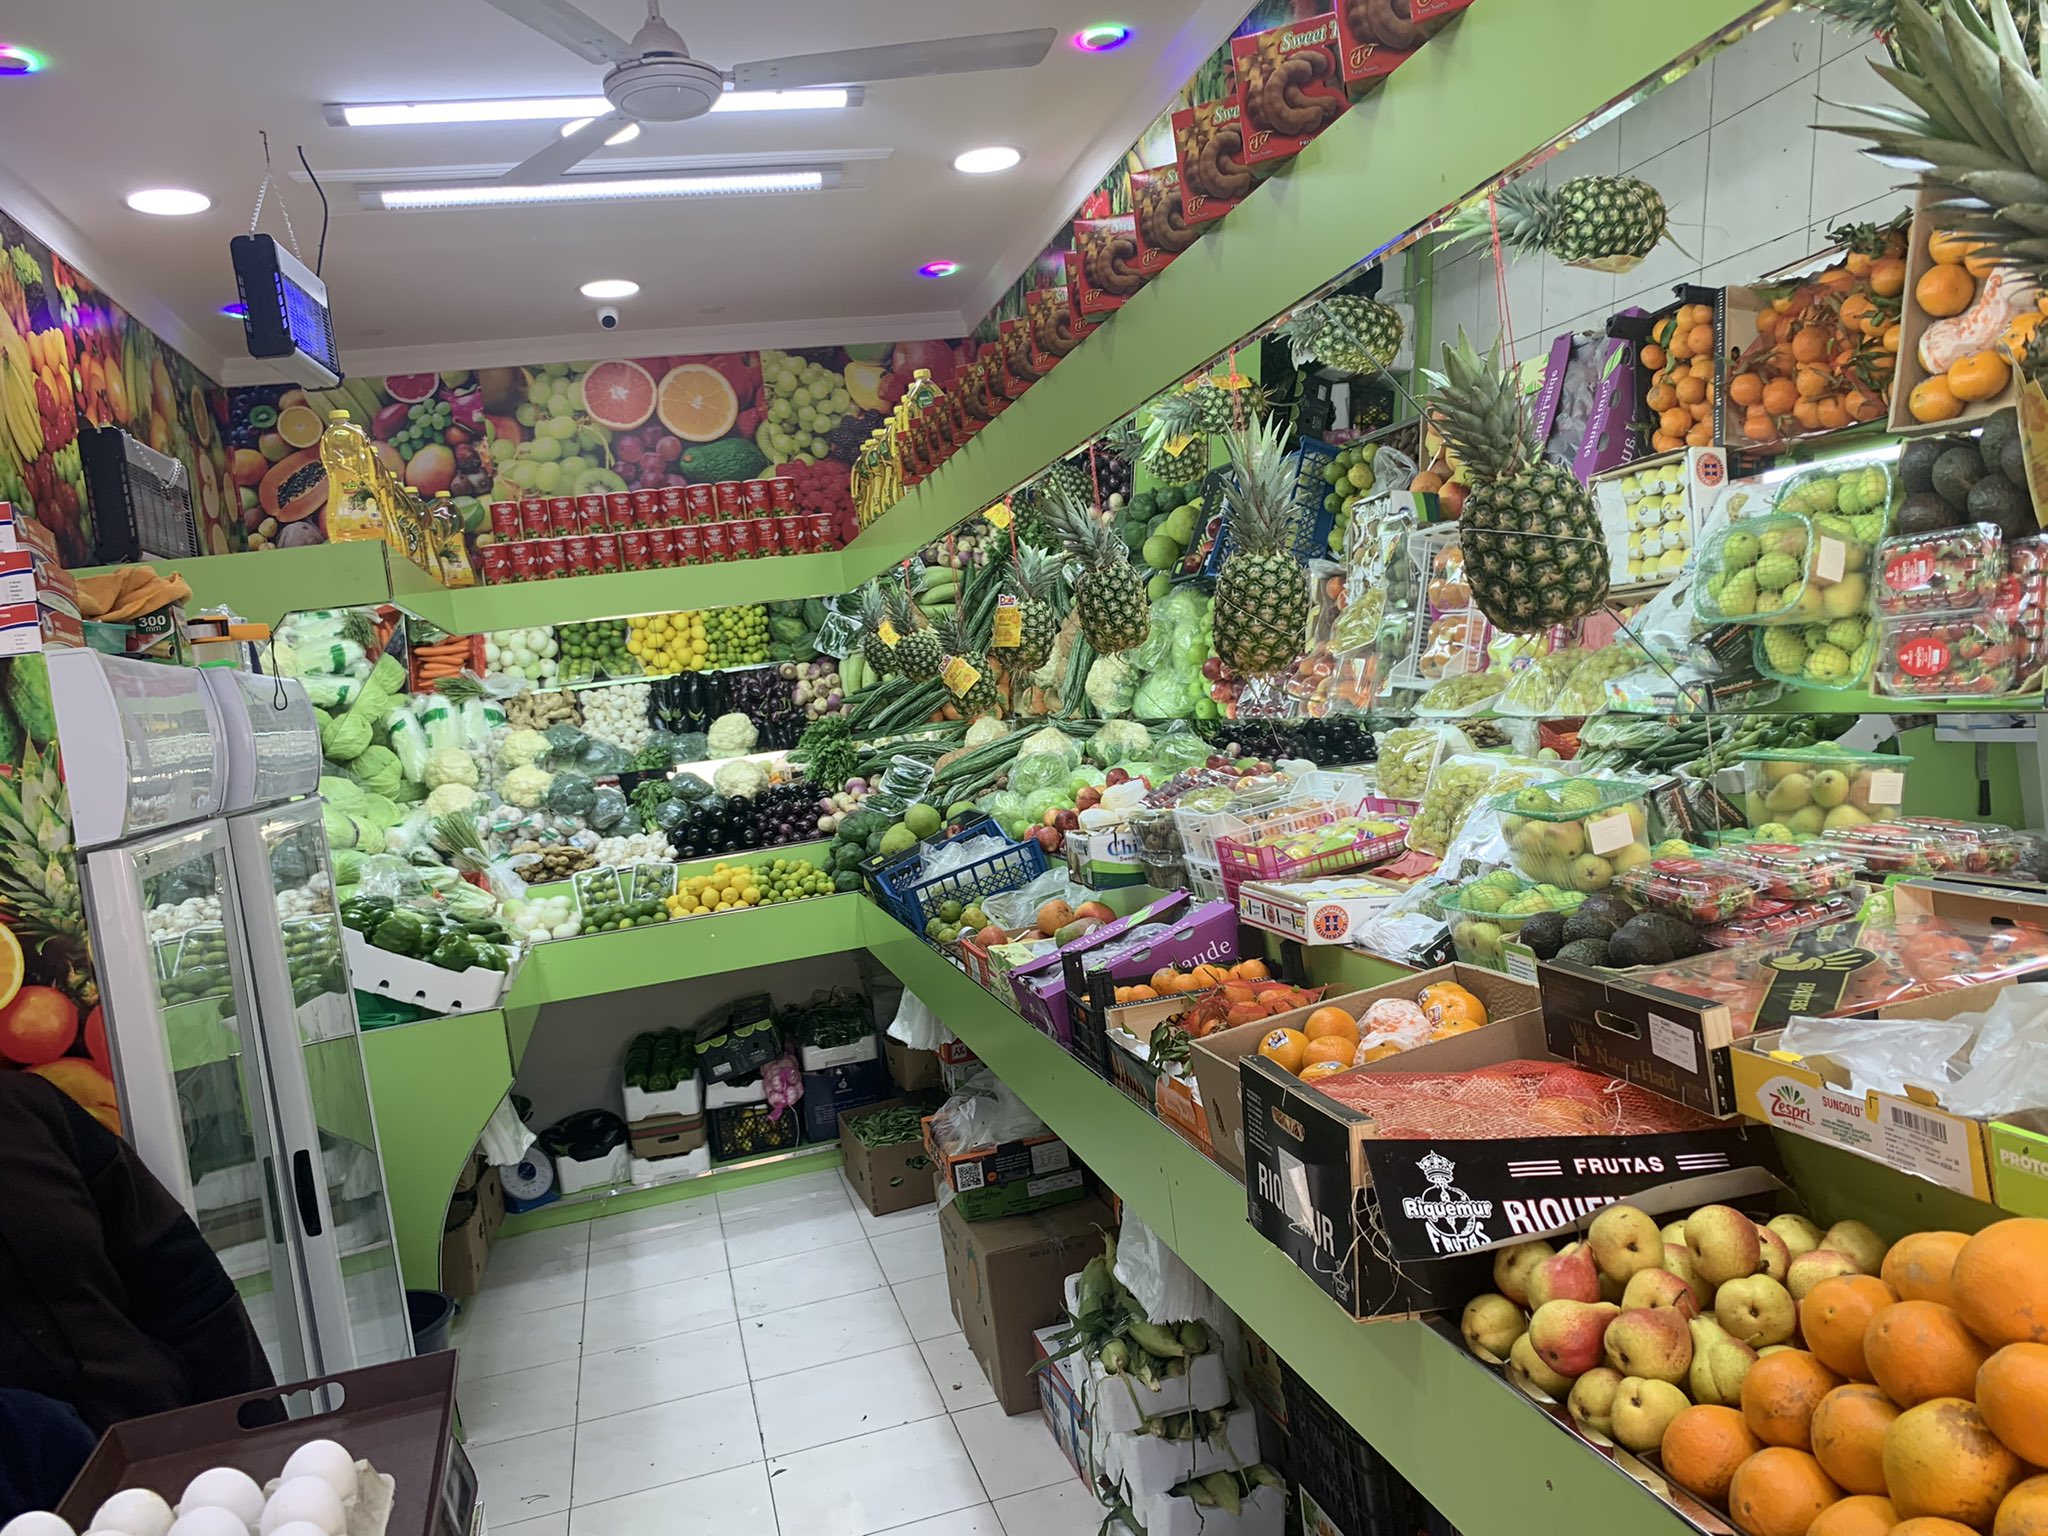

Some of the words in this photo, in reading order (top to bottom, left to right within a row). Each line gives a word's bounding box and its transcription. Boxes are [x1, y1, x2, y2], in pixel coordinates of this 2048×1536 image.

[1279, 23, 1327, 53] Sweet
[139, 615, 166, 629] 300
[145, 624, 162, 633] mm
[1594, 1046, 1638, 1075] Natural
[1639, 1059, 1677, 1092] Hand
[1769, 1092, 1812, 1122] Zespri
[1822, 1096, 1861, 1118] SUNGOLD
[1573, 1156, 1665, 1175] FRUTAS
[1402, 1199, 1493, 1222] Riquemur
[1425, 1219, 1493, 1253] FRUTAS
